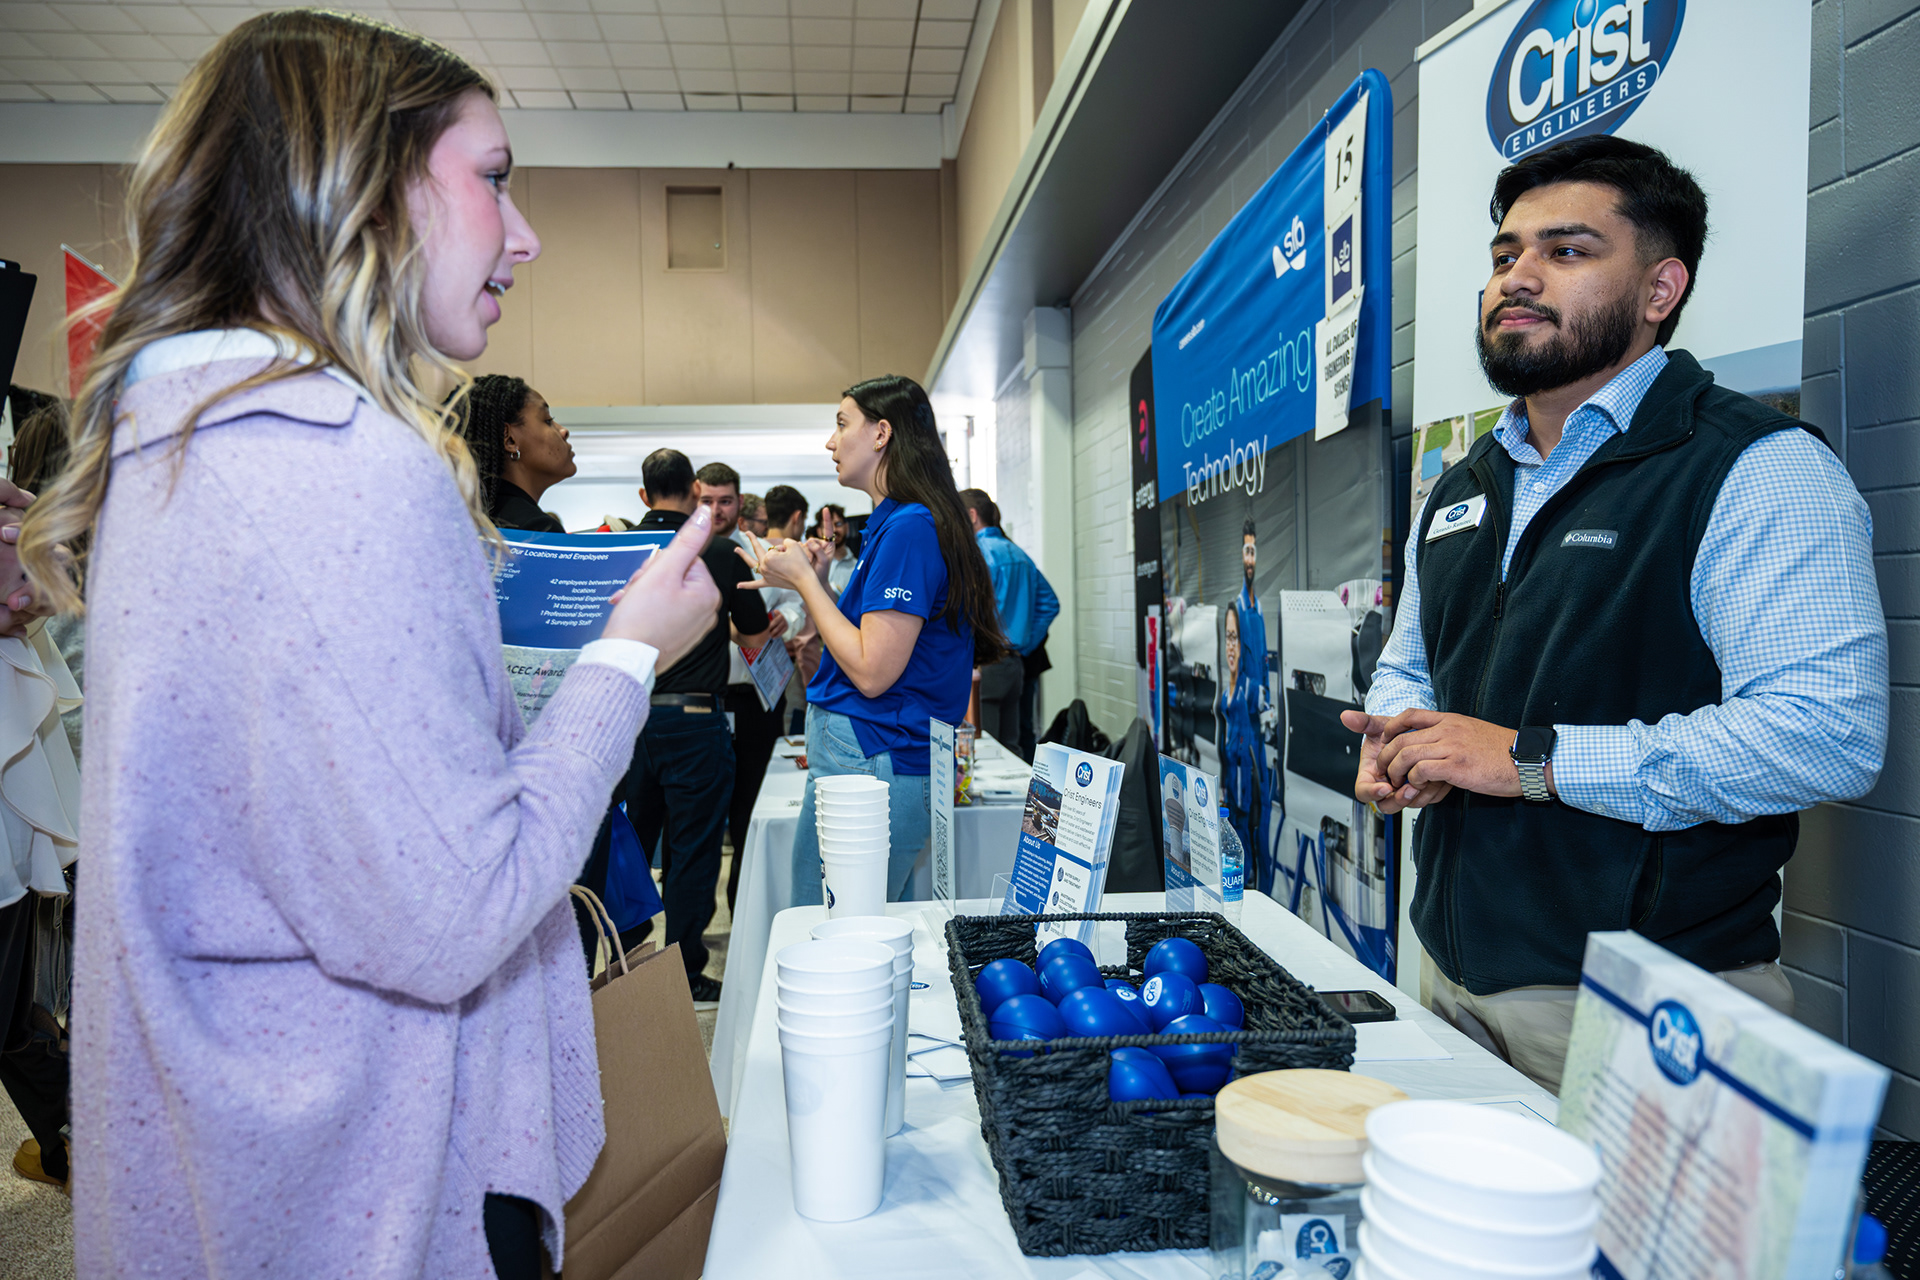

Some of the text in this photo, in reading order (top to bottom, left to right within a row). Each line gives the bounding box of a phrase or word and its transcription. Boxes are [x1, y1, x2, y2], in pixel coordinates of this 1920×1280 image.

[1508, 0, 1650, 123] Crist
[1512, 71, 1647, 153] ENGINEERS
[1334, 133, 1354, 193] 15
[1181, 326, 1311, 448] Create Amazing
[1183, 434, 1268, 507] Technology
[1571, 532, 1613, 545] Columbia
[524, 550, 558, 560] Locations
[572, 553, 610, 562] Employees
[884, 587, 912, 602] SSTC
[1077, 766, 1092, 782] Crist
[1064, 788, 1102, 810] Crist Engineers
[1196, 782, 1207, 800] Crist
[1023, 835, 1036, 847] About
[1222, 874, 1244, 888] QUAFI
[1652, 1007, 1700, 1075] Crist
